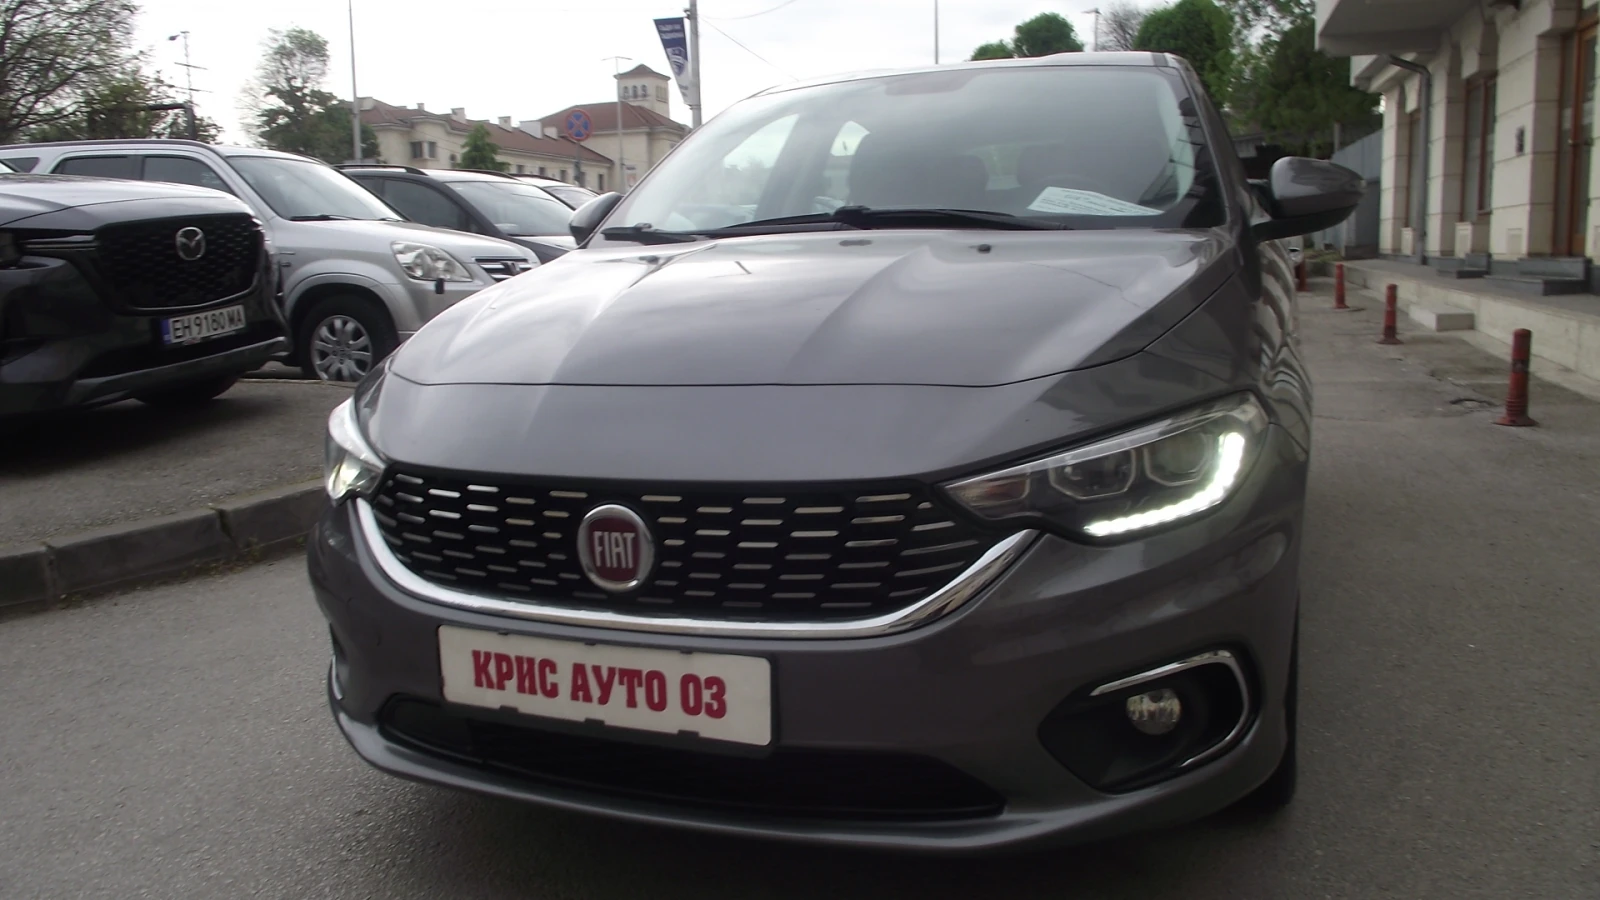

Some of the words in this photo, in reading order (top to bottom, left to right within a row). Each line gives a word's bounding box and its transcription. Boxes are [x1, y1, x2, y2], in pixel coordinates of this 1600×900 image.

[172, 319, 193, 339] EH
[593, 530, 636, 569] FIAT
[472, 649, 559, 698] КРИС
[570, 662, 668, 712] АУТО
[679, 673, 727, 719] 03
